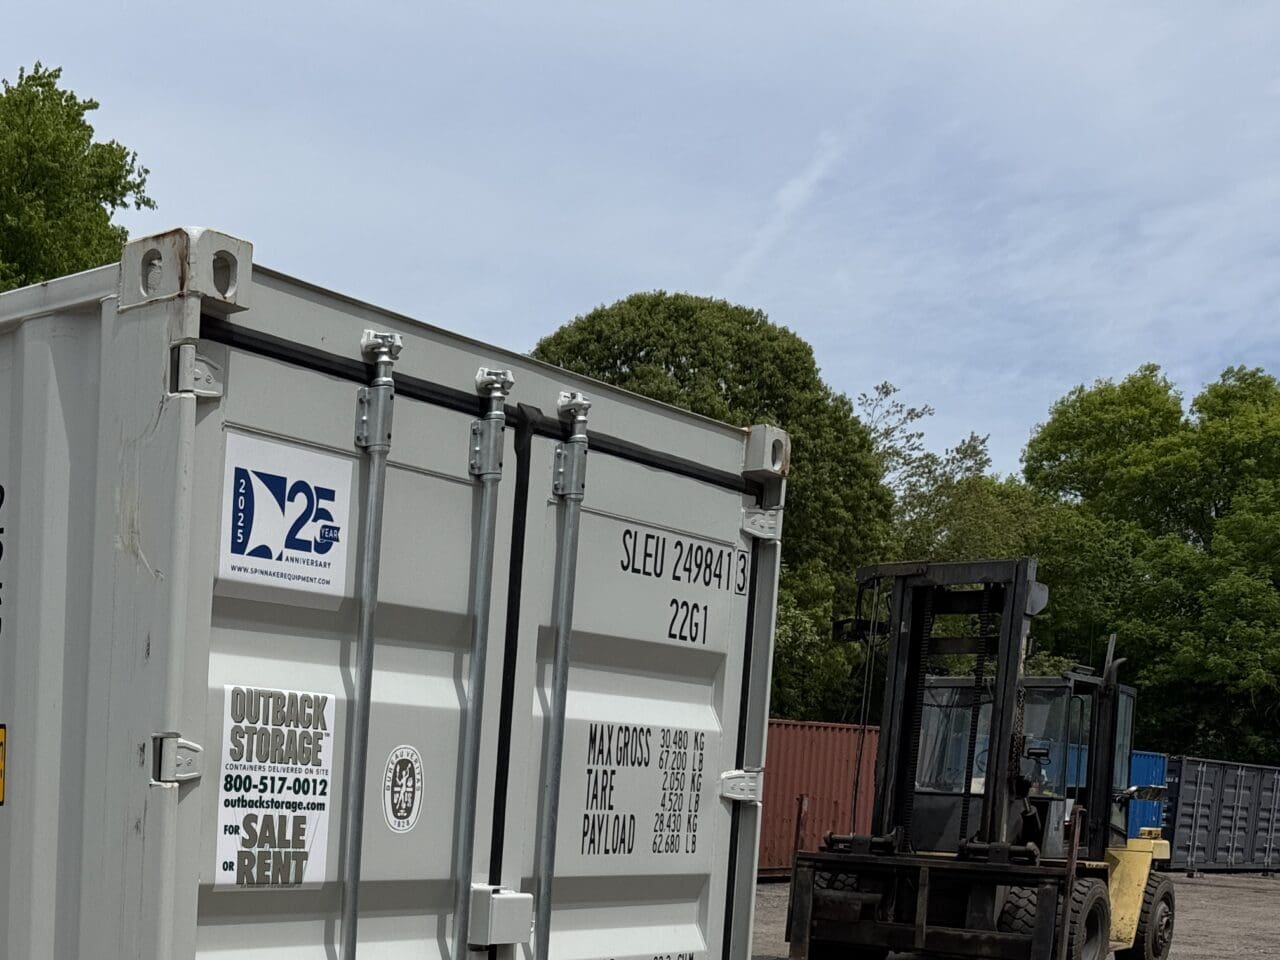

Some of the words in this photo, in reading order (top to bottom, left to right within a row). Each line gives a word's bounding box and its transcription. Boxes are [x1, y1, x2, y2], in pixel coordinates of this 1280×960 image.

[236, 479, 246, 543] 2025
[284, 479, 336, 555] 25
[320, 527, 338, 540] YEAR
[230, 564, 331, 586] WWW.SPINNAKEREQUIPMENT.COM
[285, 555, 331, 569] ANNIVERSARY
[620, 529, 666, 578] SLEU
[672, 540, 732, 590] 249841
[736, 553, 747, 593] 3
[668, 598, 708, 644] 22G1
[230, 687, 328, 731] OUTBACK
[229, 725, 324, 767] STORAGE
[587, 724, 614, 766] MAX
[616, 725, 652, 767] GROSS
[693, 731, 705, 751] KG
[692, 752, 704, 772] LB
[223, 773, 328, 796] 800-517-0012
[224, 763, 266, 773] CONTAINERS
[268, 765, 302, 775] DELIVERED
[304, 767, 314, 775] ON
[316, 768, 329, 776] SITE
[223, 795, 326, 813] outbackstorage.com
[585, 769, 616, 811] TARE
[690, 773, 702, 792] KG
[688, 793, 700, 813] LB
[223, 825, 240, 835] FOR
[241, 813, 306, 849] SALE
[581, 813, 636, 855] PAYLOAD
[686, 814, 697, 833] KG
[685, 834, 696, 854] LB
[222, 861, 234, 872] OR
[236, 850, 308, 885] RENT
